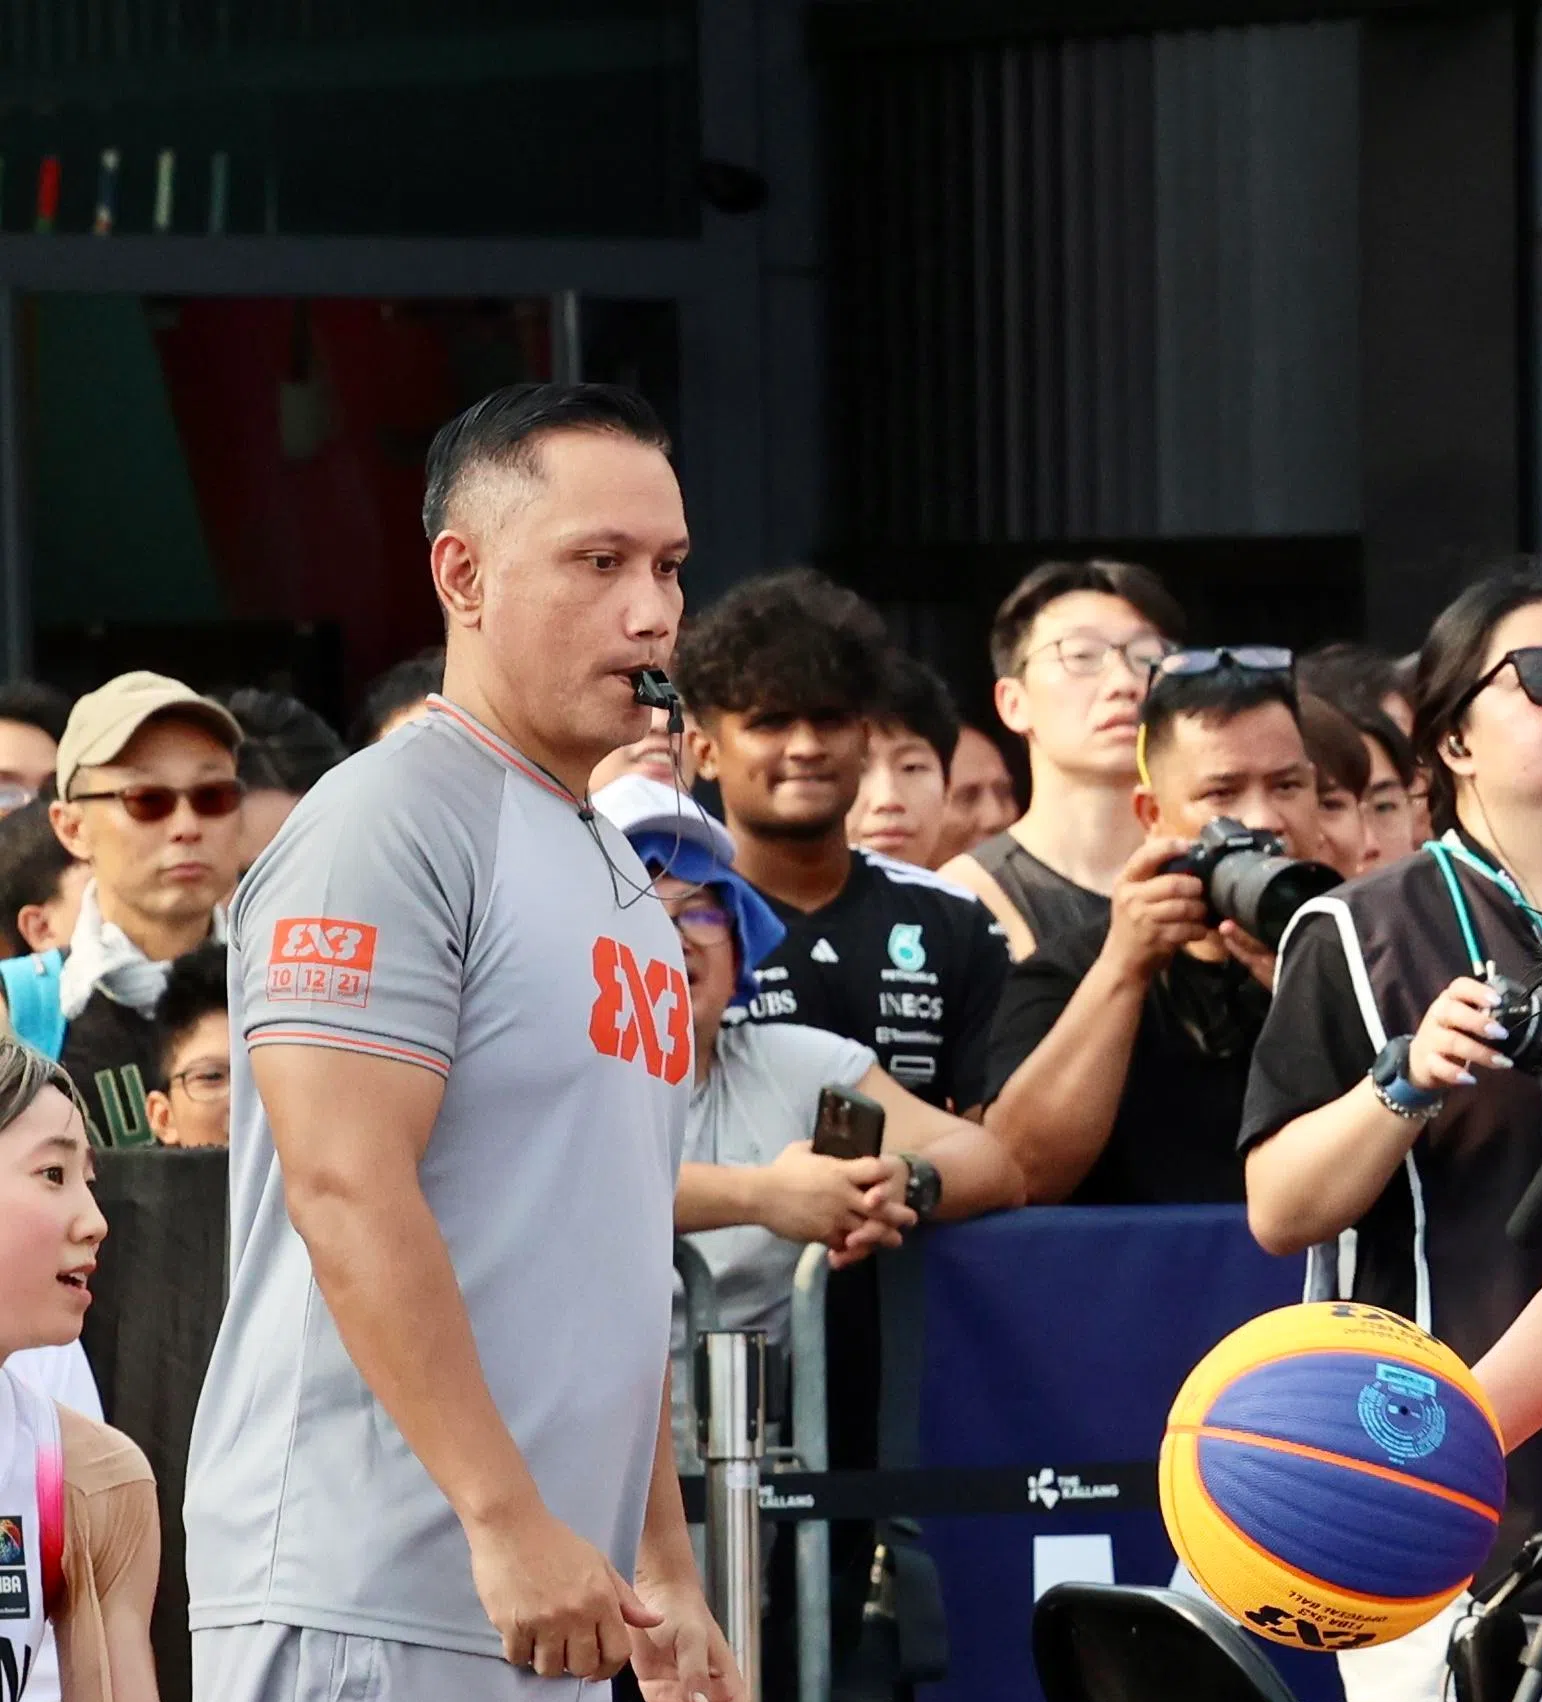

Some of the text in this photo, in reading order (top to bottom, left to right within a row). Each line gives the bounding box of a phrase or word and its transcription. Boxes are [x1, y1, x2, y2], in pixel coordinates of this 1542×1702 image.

[305, 968, 327, 988] 12
[337, 973, 361, 994] 21
[749, 988, 798, 1020] UBS
[878, 991, 944, 1021] INEOS
[1288, 1590, 1389, 1623] OFFICIAL BALL
[1328, 1618, 1365, 1631] FIBA
